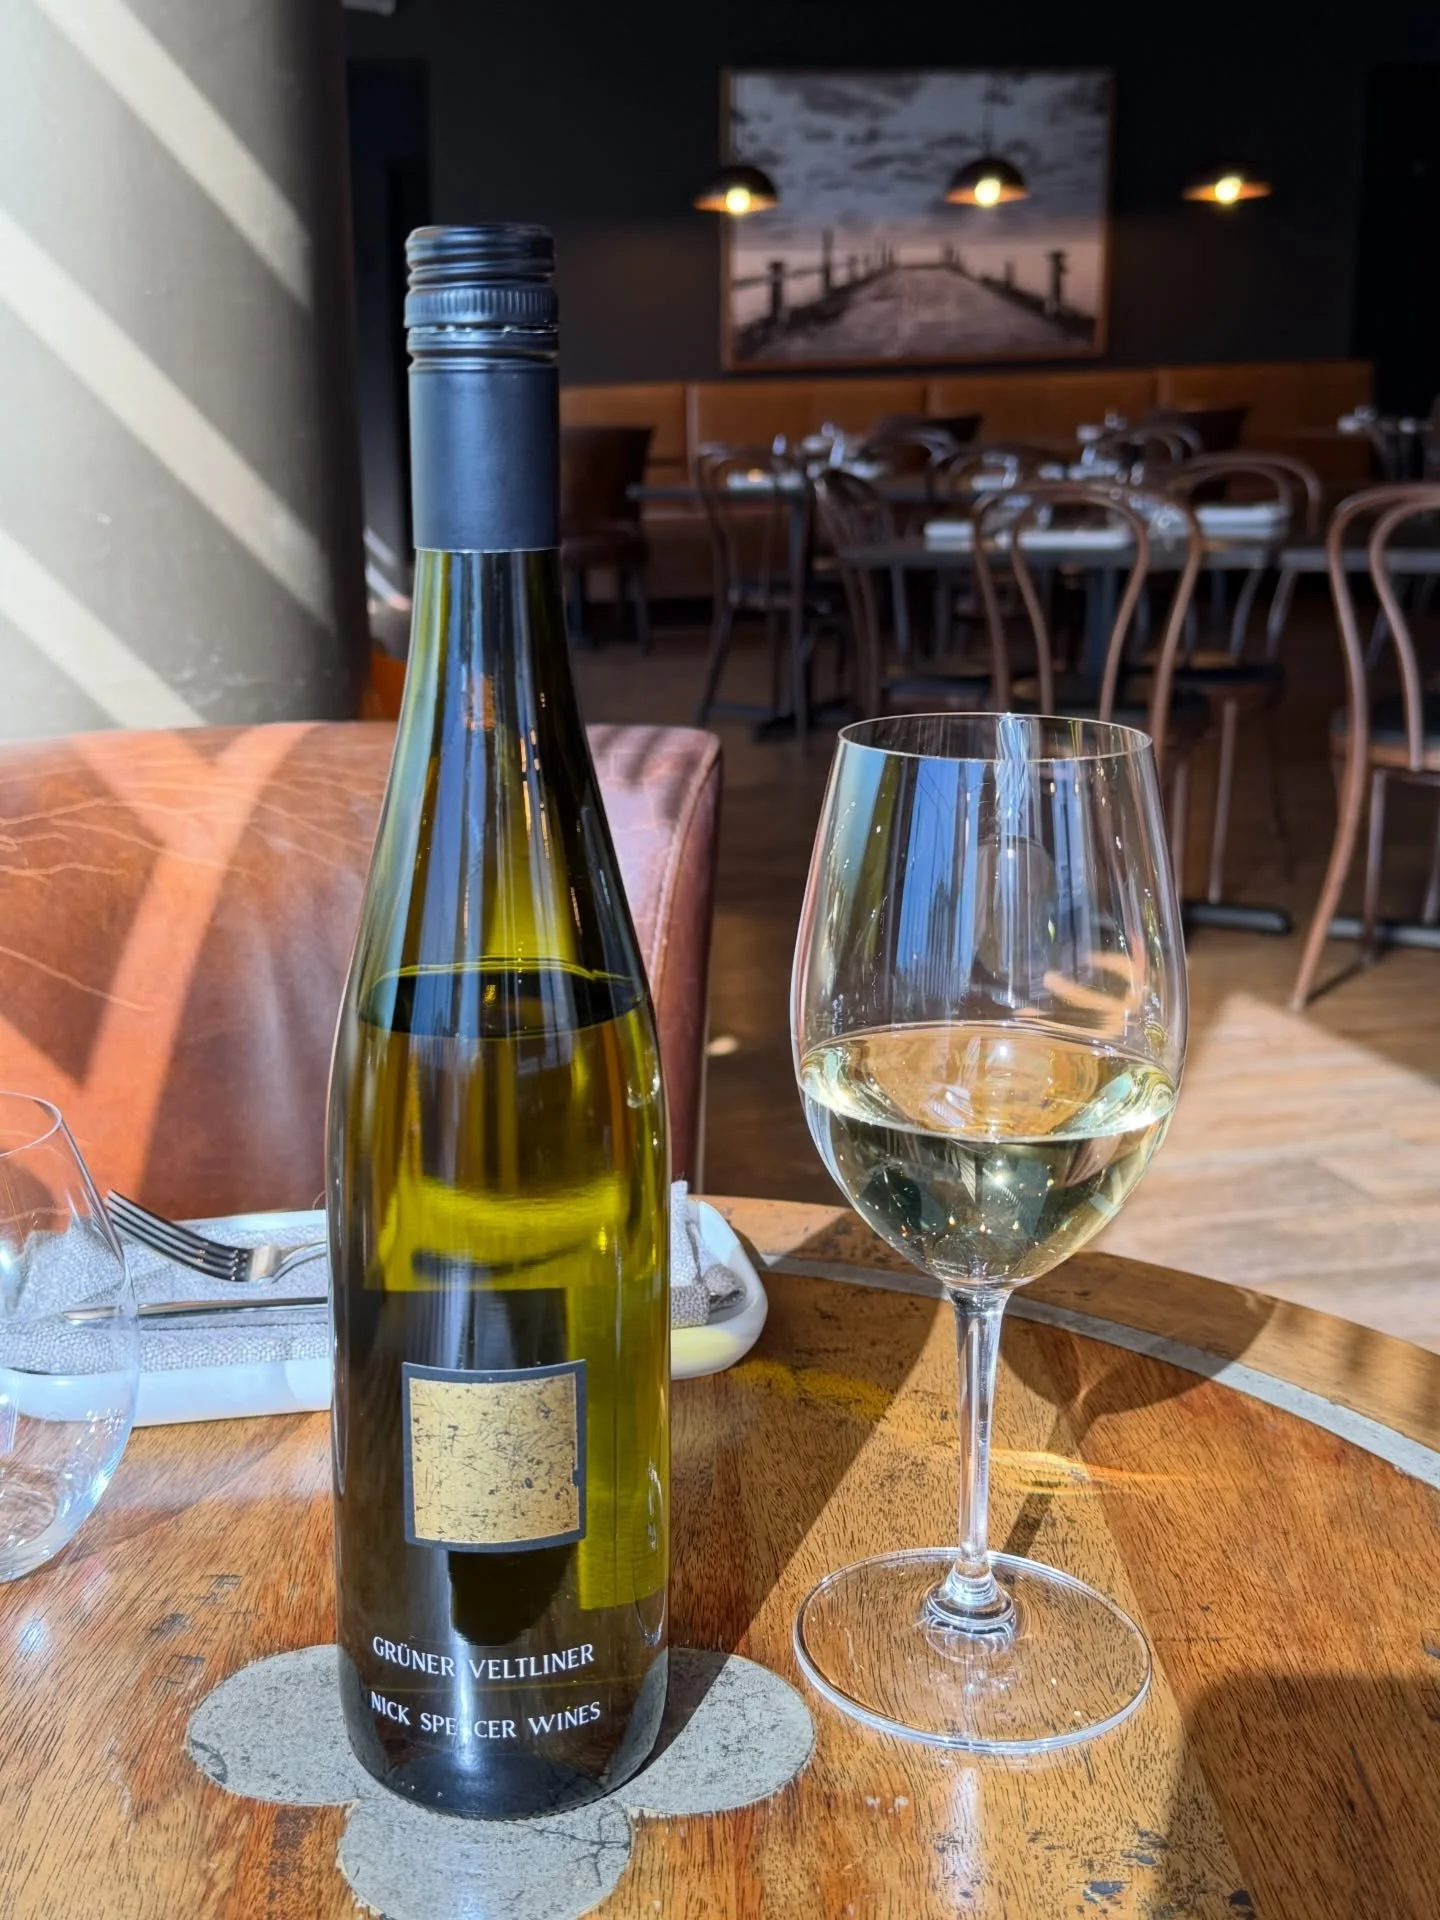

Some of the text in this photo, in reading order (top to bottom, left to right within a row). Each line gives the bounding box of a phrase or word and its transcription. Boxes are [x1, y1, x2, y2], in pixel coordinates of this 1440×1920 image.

[373, 1636, 594, 1679] GRÜNER VELTLINER
[371, 1691, 600, 1738] NICK SPECER WINES
